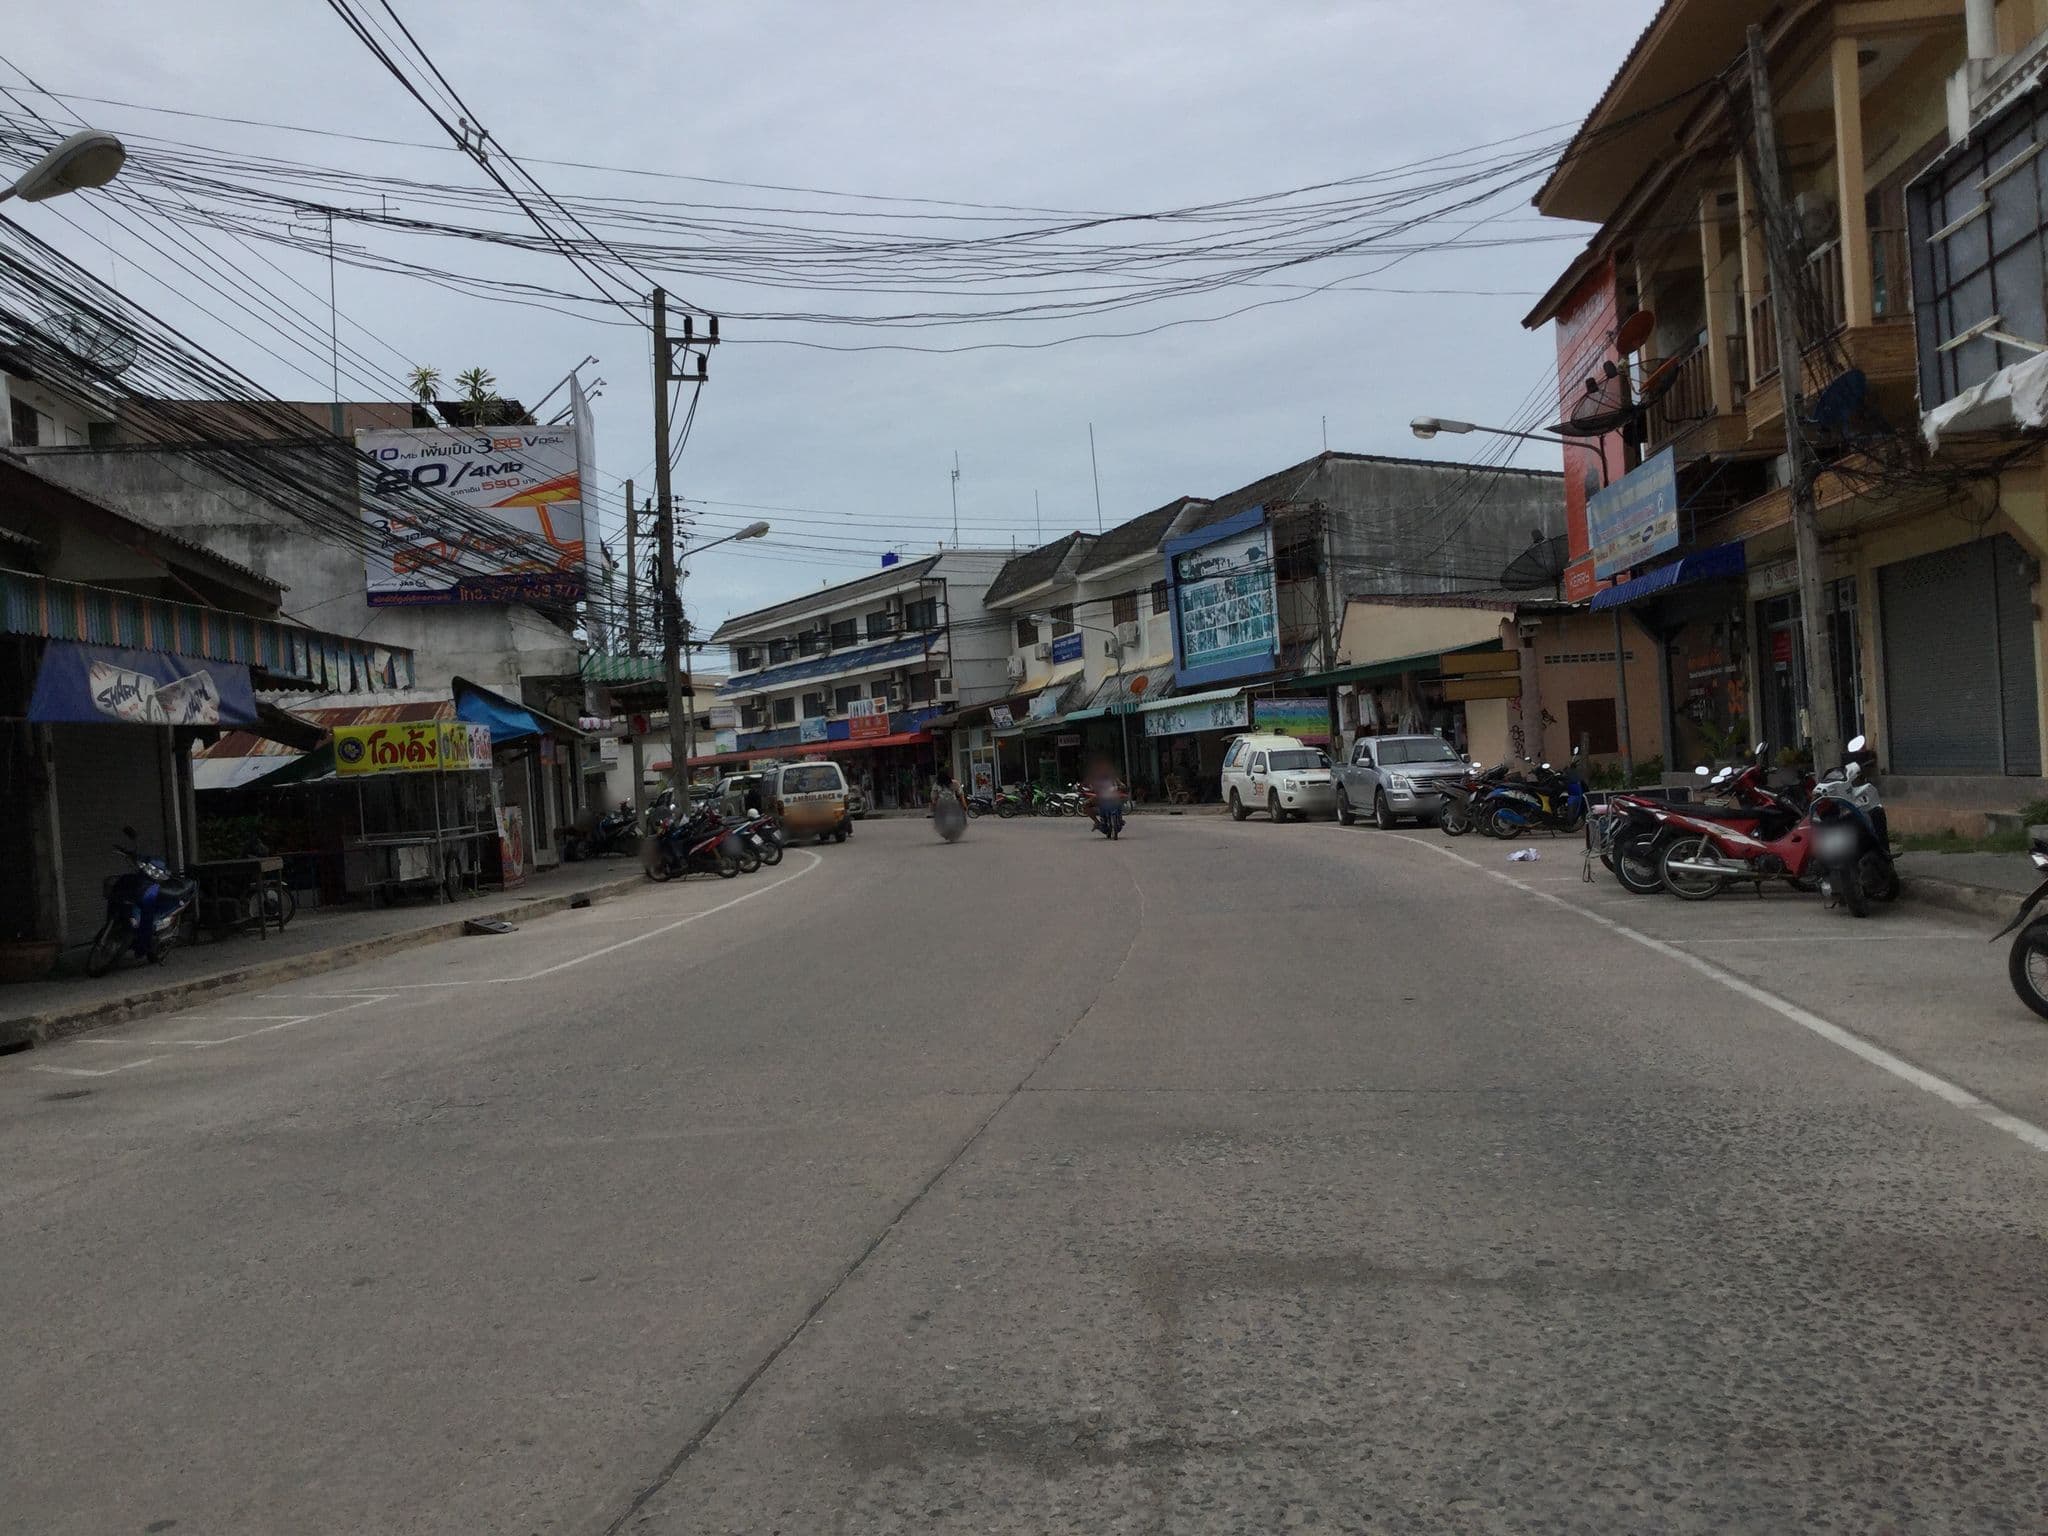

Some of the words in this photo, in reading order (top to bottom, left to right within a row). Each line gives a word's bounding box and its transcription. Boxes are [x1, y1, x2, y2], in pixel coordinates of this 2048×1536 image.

[482, 479, 520, 491] 590
[97, 673, 144, 713] SHARK
[793, 793, 836, 803] AMBULANCE
